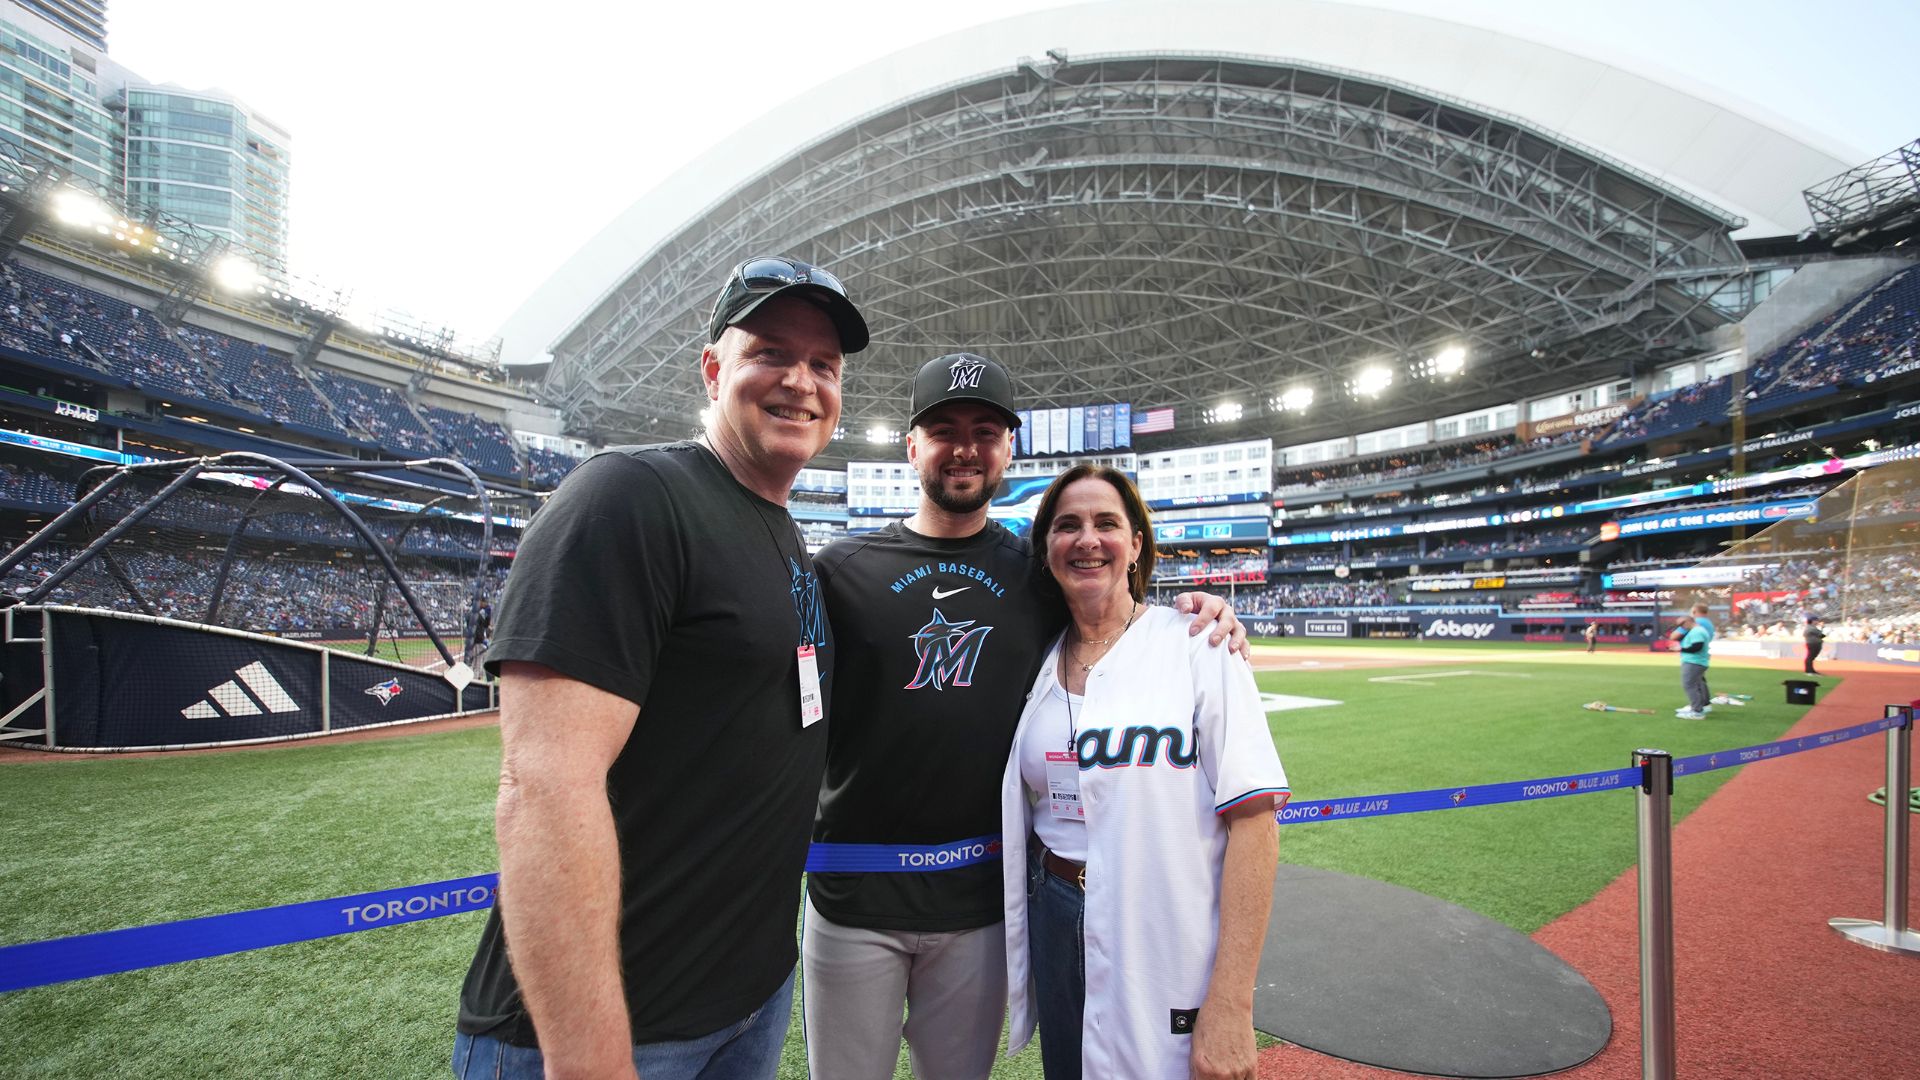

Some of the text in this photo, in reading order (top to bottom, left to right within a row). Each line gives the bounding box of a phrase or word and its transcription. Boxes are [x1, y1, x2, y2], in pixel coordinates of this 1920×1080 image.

[55, 401, 99, 423] KPMG
[1763, 431, 1814, 448] HALLADAY
[1621, 523, 1643, 534] JOIN
[1644, 521, 1659, 531] US
[1661, 518, 1677, 528] AT
[1680, 514, 1704, 526] THE
[1706, 509, 1760, 524] PORCH!
[891, 563, 1005, 598] MIAMI BASEBALL
[1209, 570, 1265, 583] ROGERS
[1425, 619, 1494, 638] Sobeys
[1523, 774, 1620, 797] TORONTO BLUE JAYS
[1332, 802, 1360, 815] BLUE
[1361, 800, 1389, 812] JAYS
[898, 843, 985, 867] TORONTO
[341, 886, 489, 926] TORONTO
